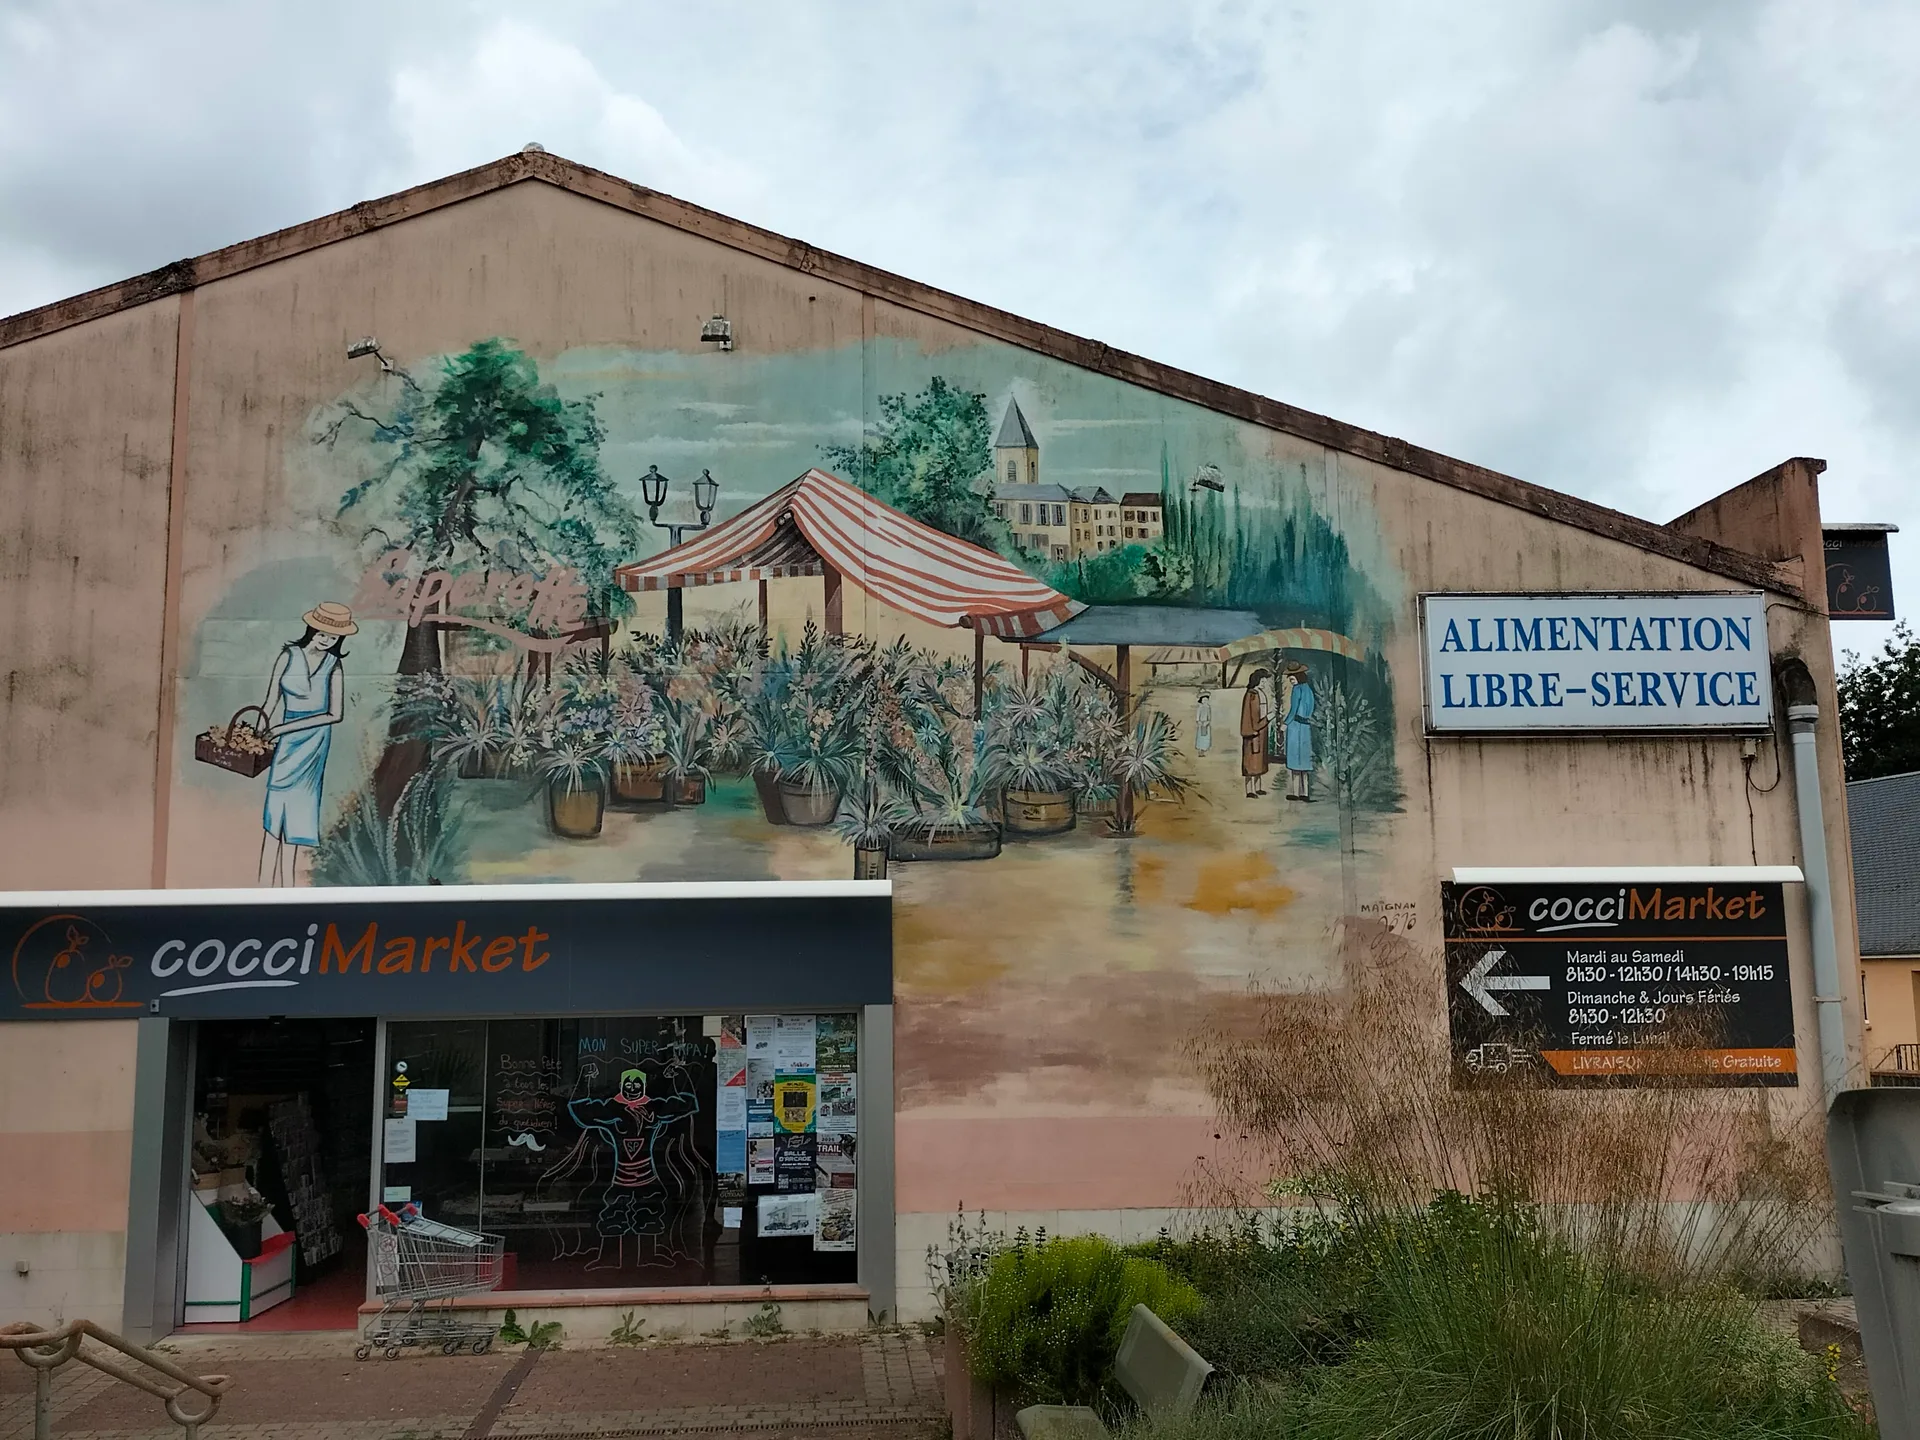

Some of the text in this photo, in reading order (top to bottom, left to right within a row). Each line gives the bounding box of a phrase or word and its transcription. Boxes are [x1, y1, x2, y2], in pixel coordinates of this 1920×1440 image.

[1439, 616, 1752, 652] ALIMENTATION
[1440, 671, 1761, 708] LIBRE-SERVICE
[1528, 887, 1766, 921] cocciMarket
[150, 920, 551, 977] cocciMarket
[1567, 950, 1684, 963] Mardi au Samedi
[1566, 966, 1607, 982] 8h30
[1618, 966, 1663, 981] 12h30
[1675, 965, 1721, 981] 14h30
[1732, 964, 1774, 981] 19h15
[1568, 988, 1741, 1004] Dimanche & Jours Fériés
[1568, 1008, 1609, 1024] 8h30
[1620, 1008, 1666, 1024] 12h30
[1571, 1030, 1613, 1045] Fermé
[1617, 1031, 1629, 1045] le
[579, 1037, 606, 1055] MON
[620, 1038, 659, 1055] SUPER
[500, 1053, 537, 1070] Bonne
[1723, 1055, 1782, 1068] Gratuite
[627, 1141, 640, 1153] SP
[816, 1144, 841, 1153] TRAIL
